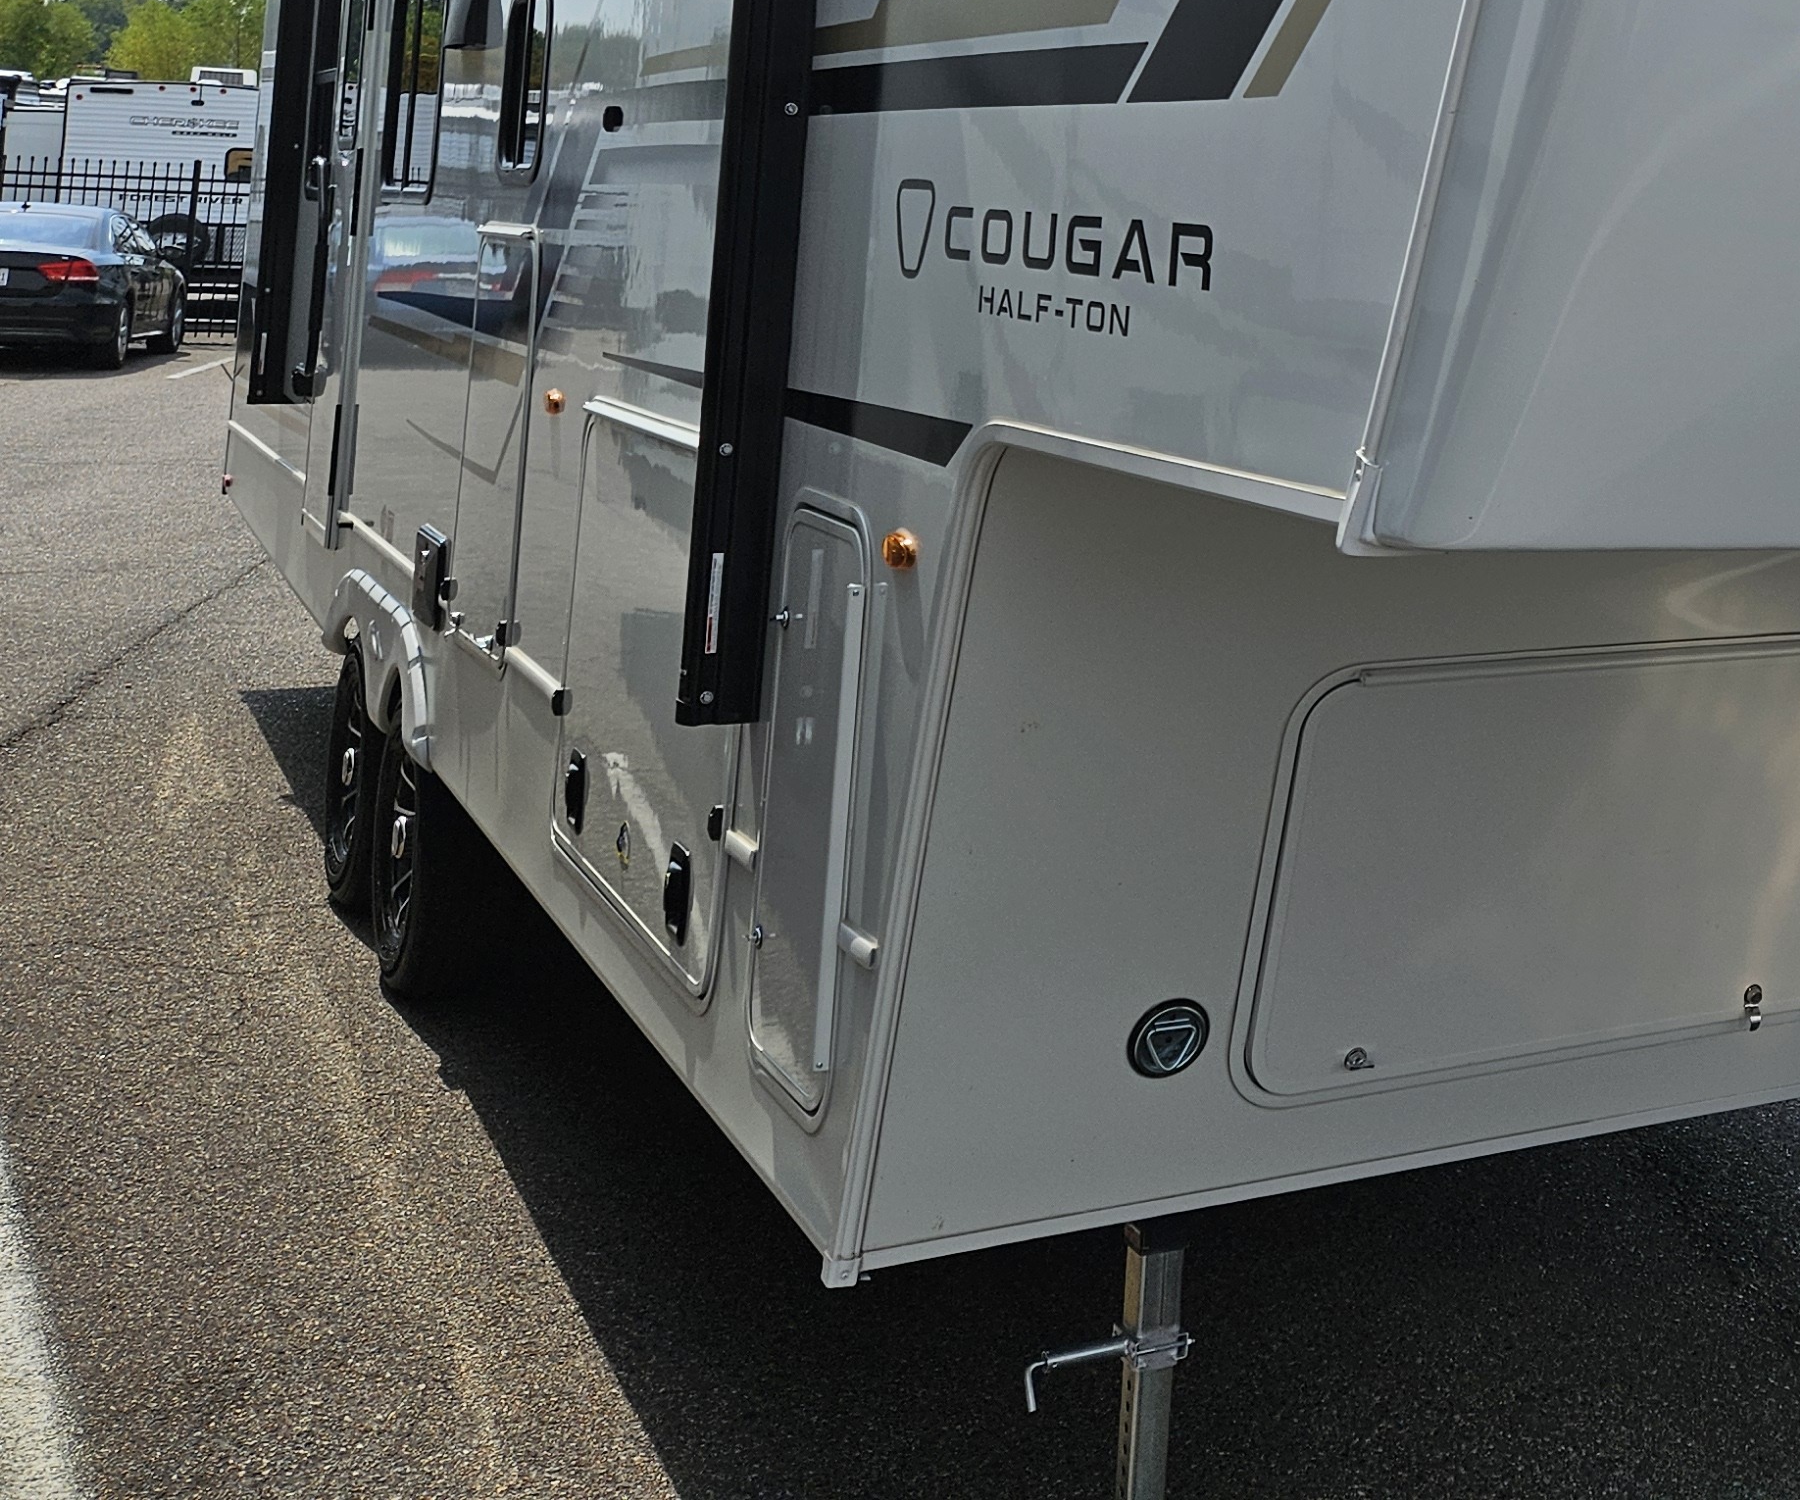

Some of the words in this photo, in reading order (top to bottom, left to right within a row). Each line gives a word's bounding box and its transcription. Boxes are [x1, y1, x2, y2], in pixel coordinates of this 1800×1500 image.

[119, 193, 188, 203] FOREST
[945, 205, 1214, 291] COUGAR
[978, 285, 1130, 337] HALF-TON
